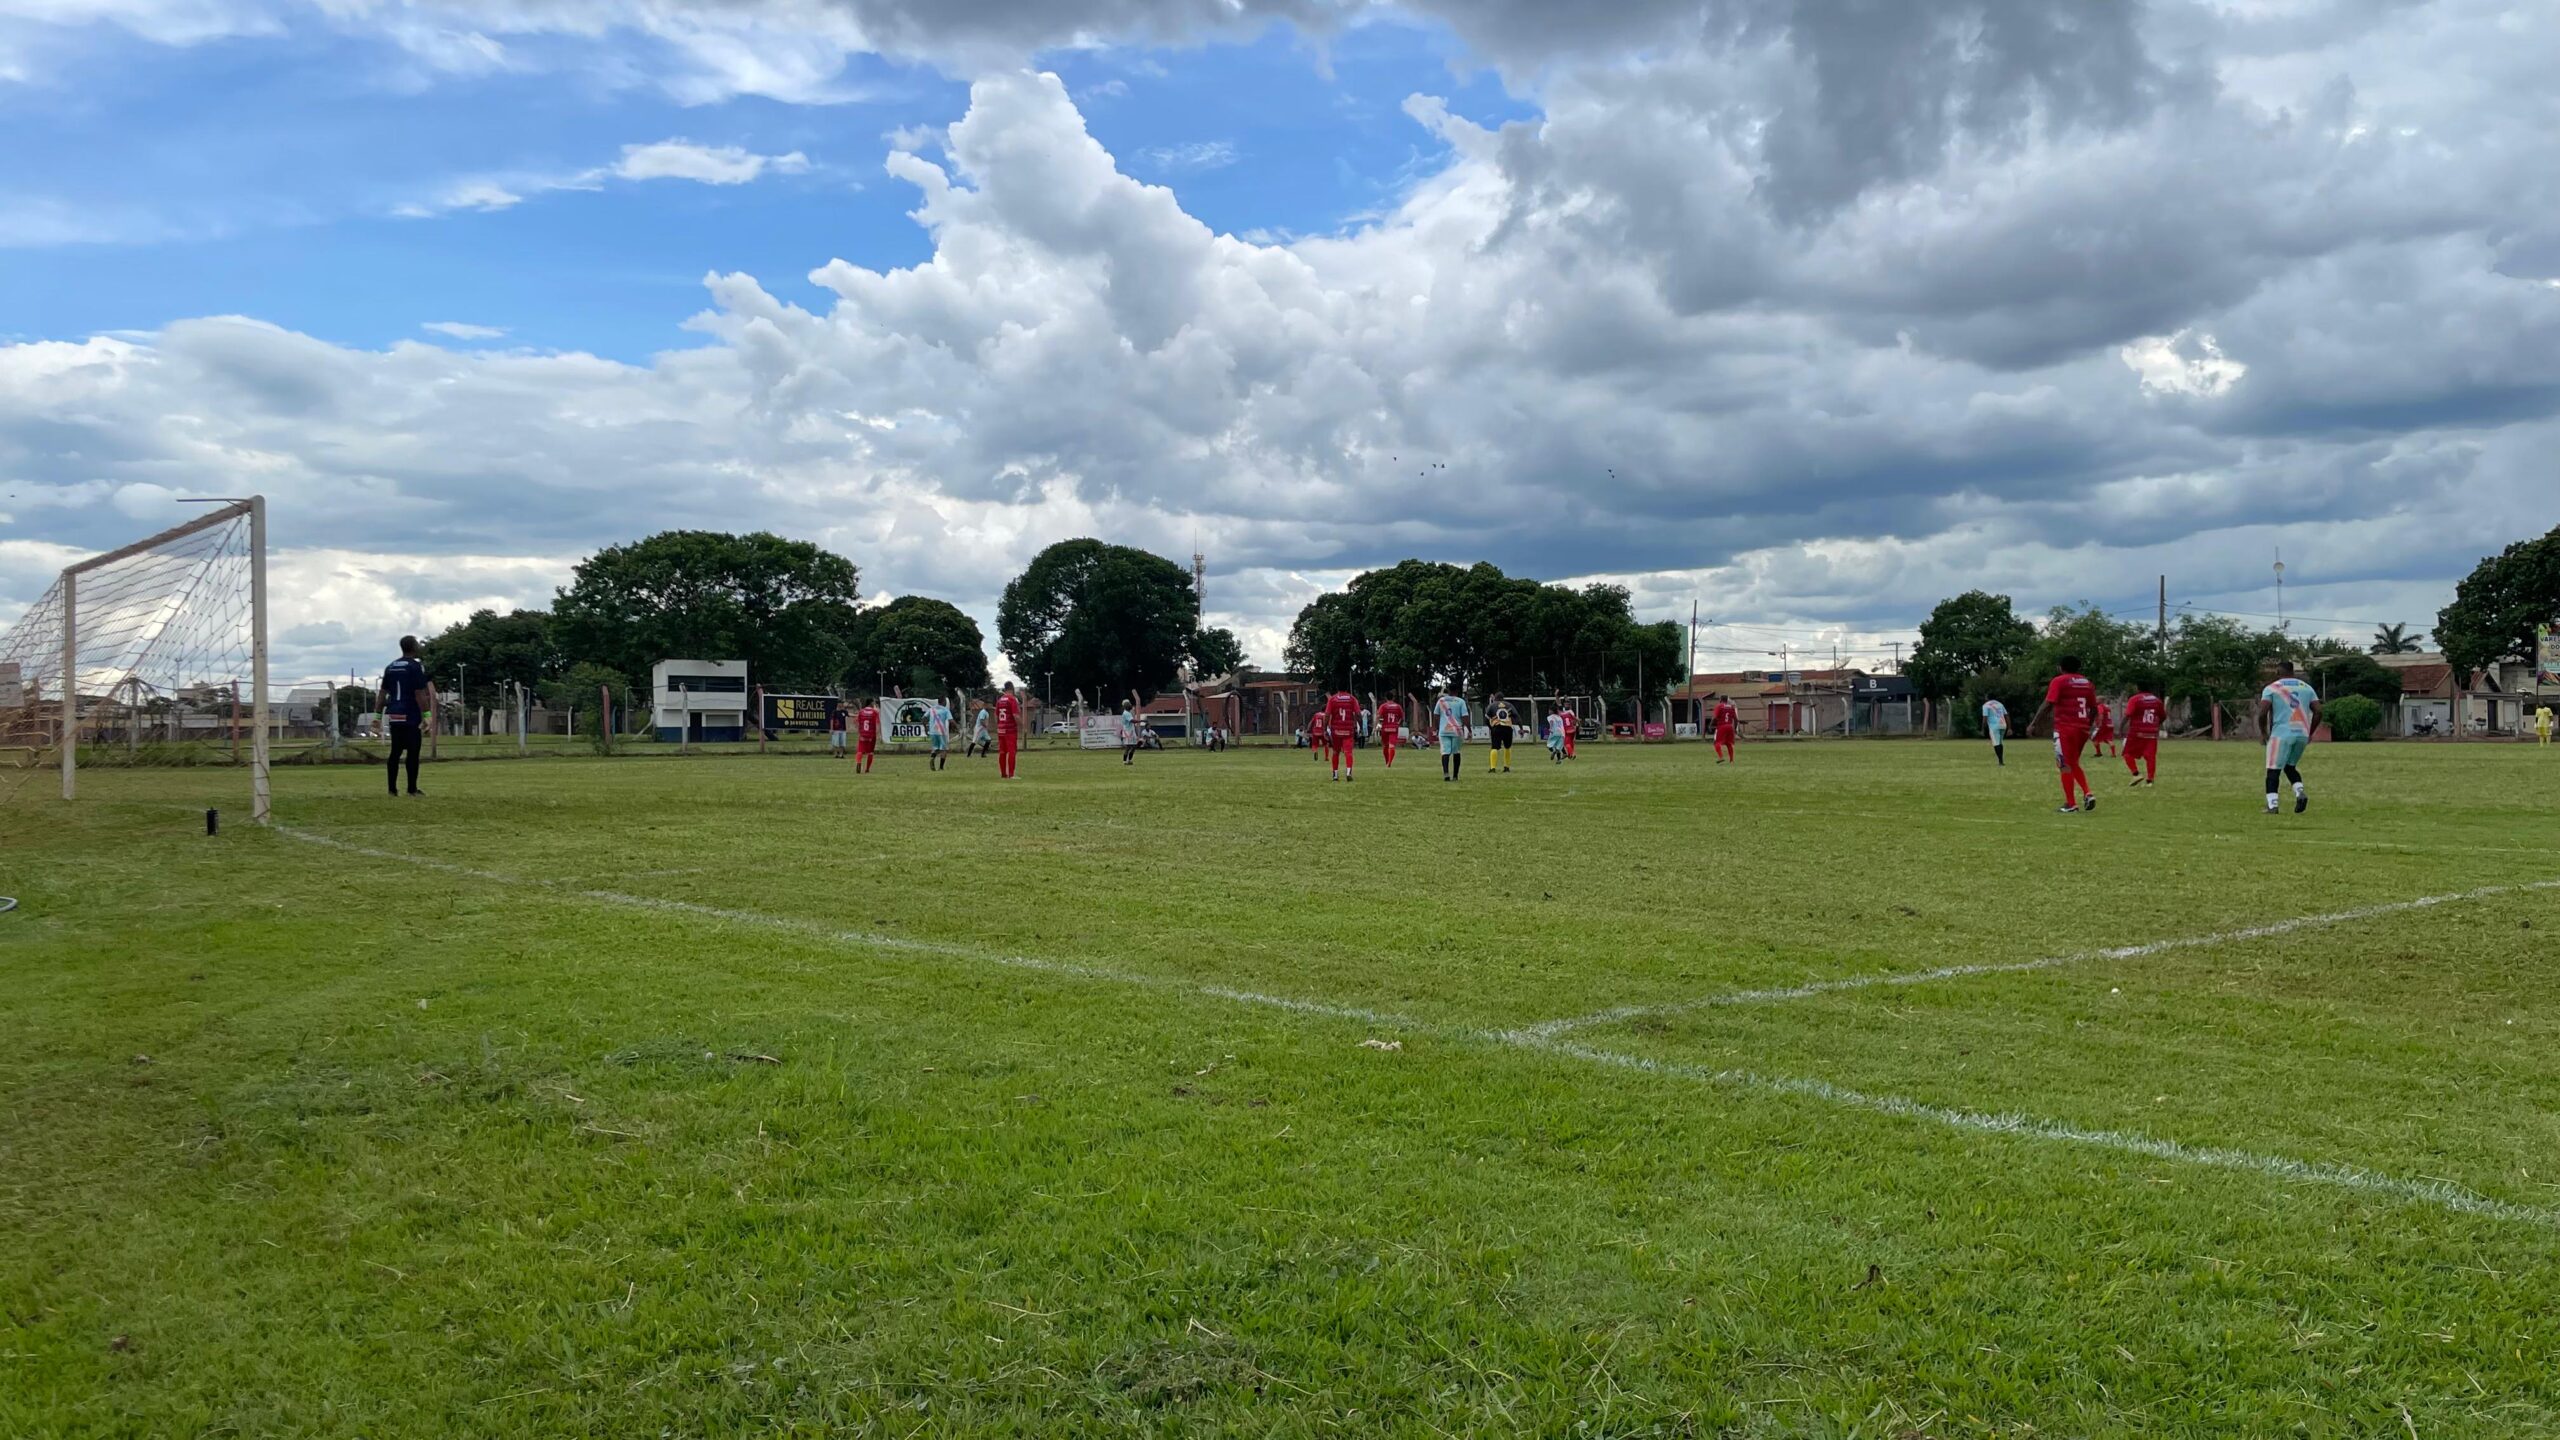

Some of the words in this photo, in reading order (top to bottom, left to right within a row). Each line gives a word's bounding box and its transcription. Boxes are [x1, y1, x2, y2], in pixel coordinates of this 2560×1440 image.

[1869, 679, 1877, 689] B
[397, 680, 401, 701] 1
[795, 699, 825, 711] REALCE
[2077, 697, 2087, 718] 3
[1339, 708, 1346, 721] 4
[2142, 709, 2155, 723] 16
[863, 720, 870, 731] 6
[891, 725, 921, 737] AGRO
